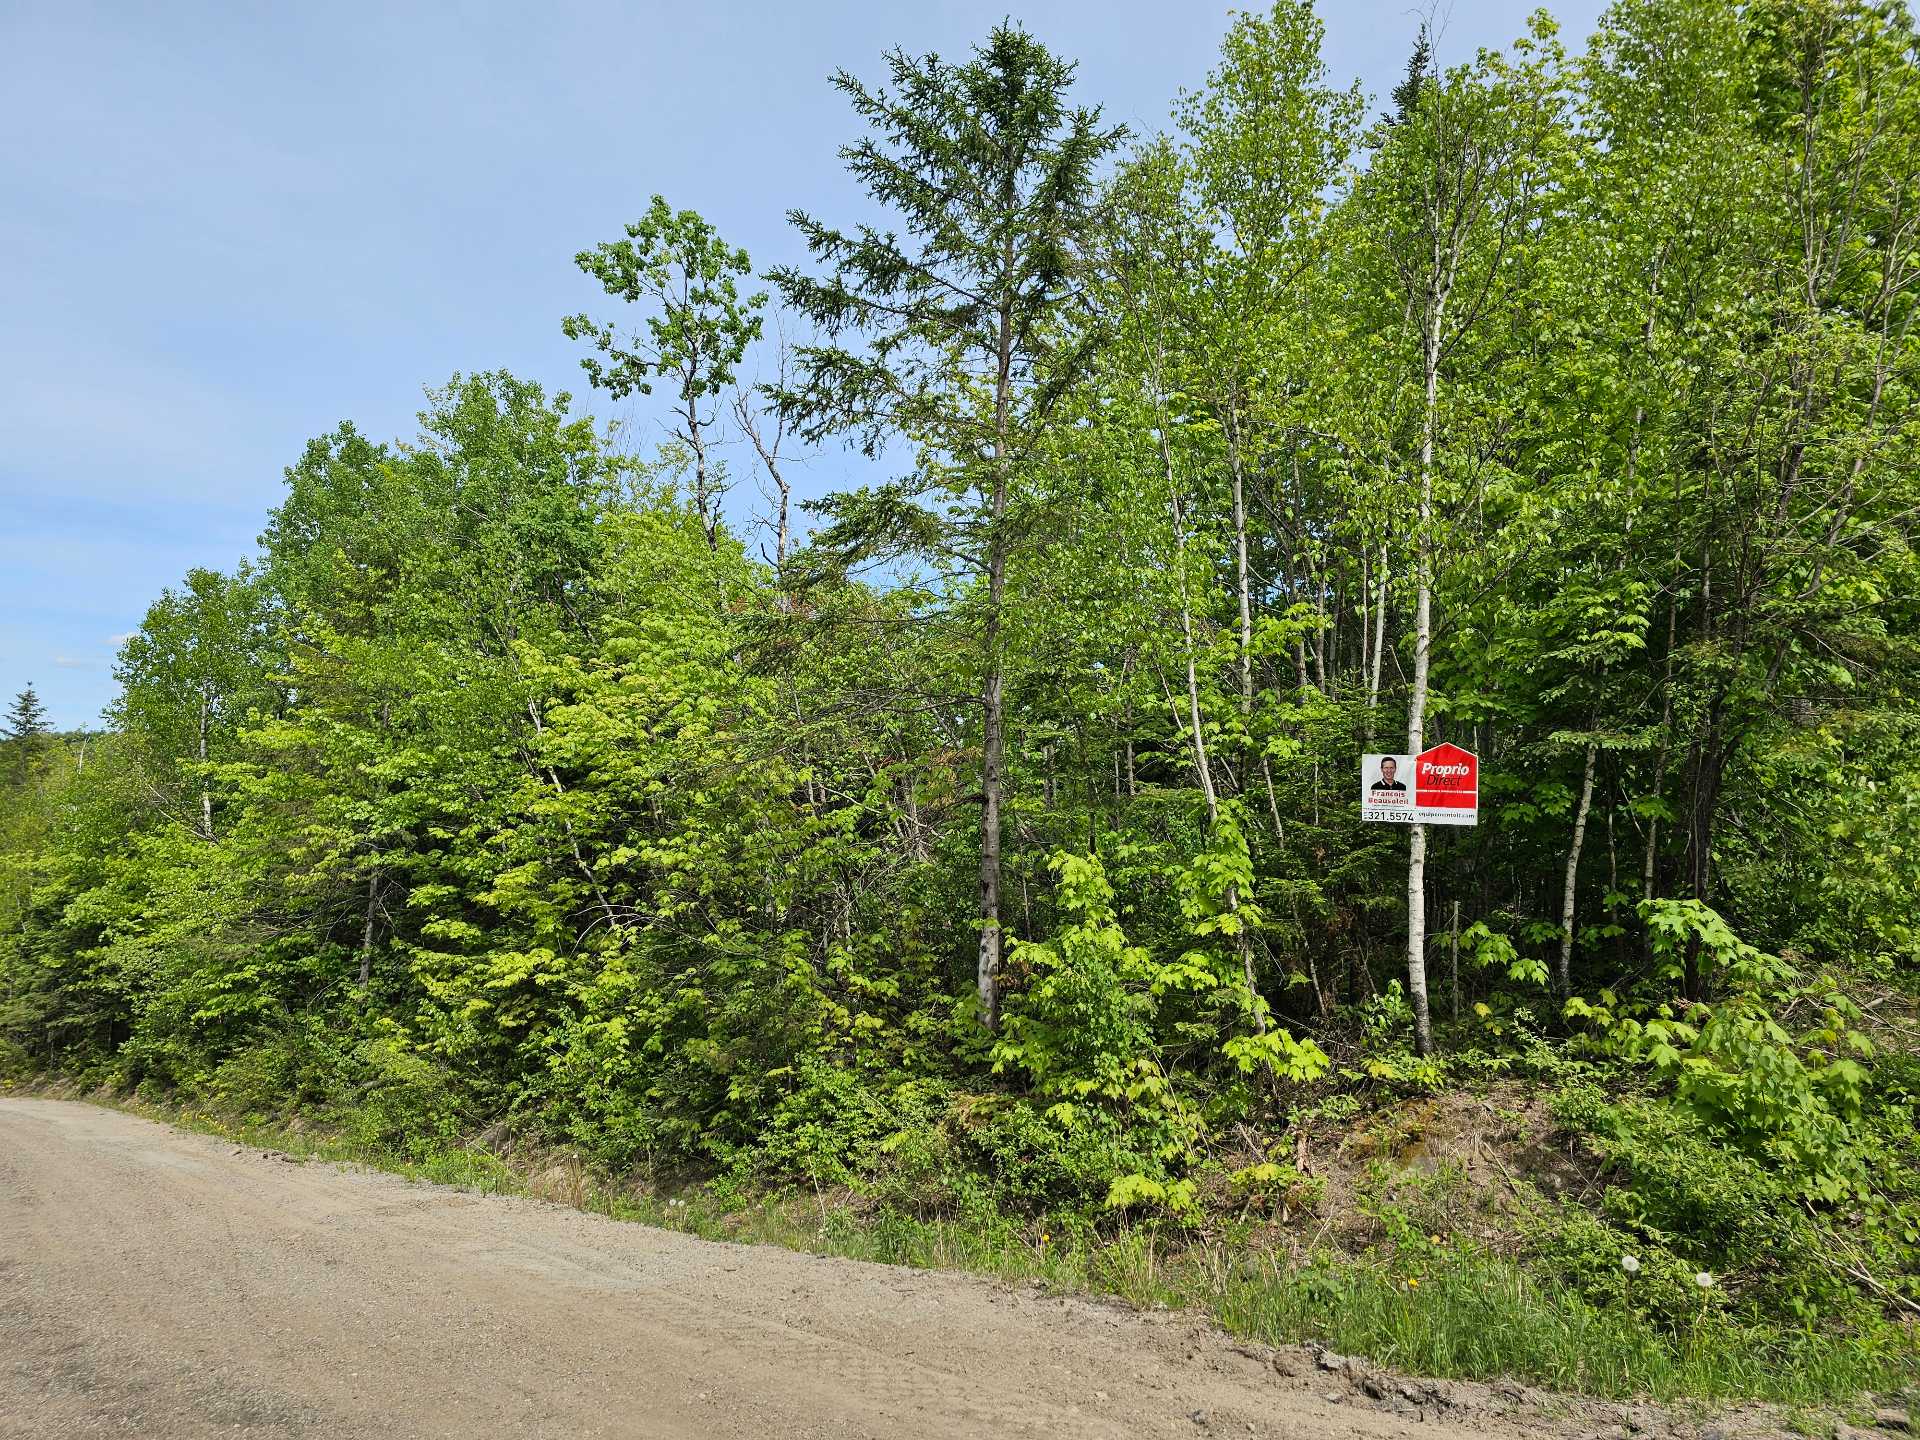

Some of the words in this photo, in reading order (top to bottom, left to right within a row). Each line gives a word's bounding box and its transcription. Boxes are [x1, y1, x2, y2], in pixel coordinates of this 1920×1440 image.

[1422, 762, 1470, 778] Proprio
[1426, 774, 1464, 786] Direct
[1368, 811, 1414, 821] 321.5574
